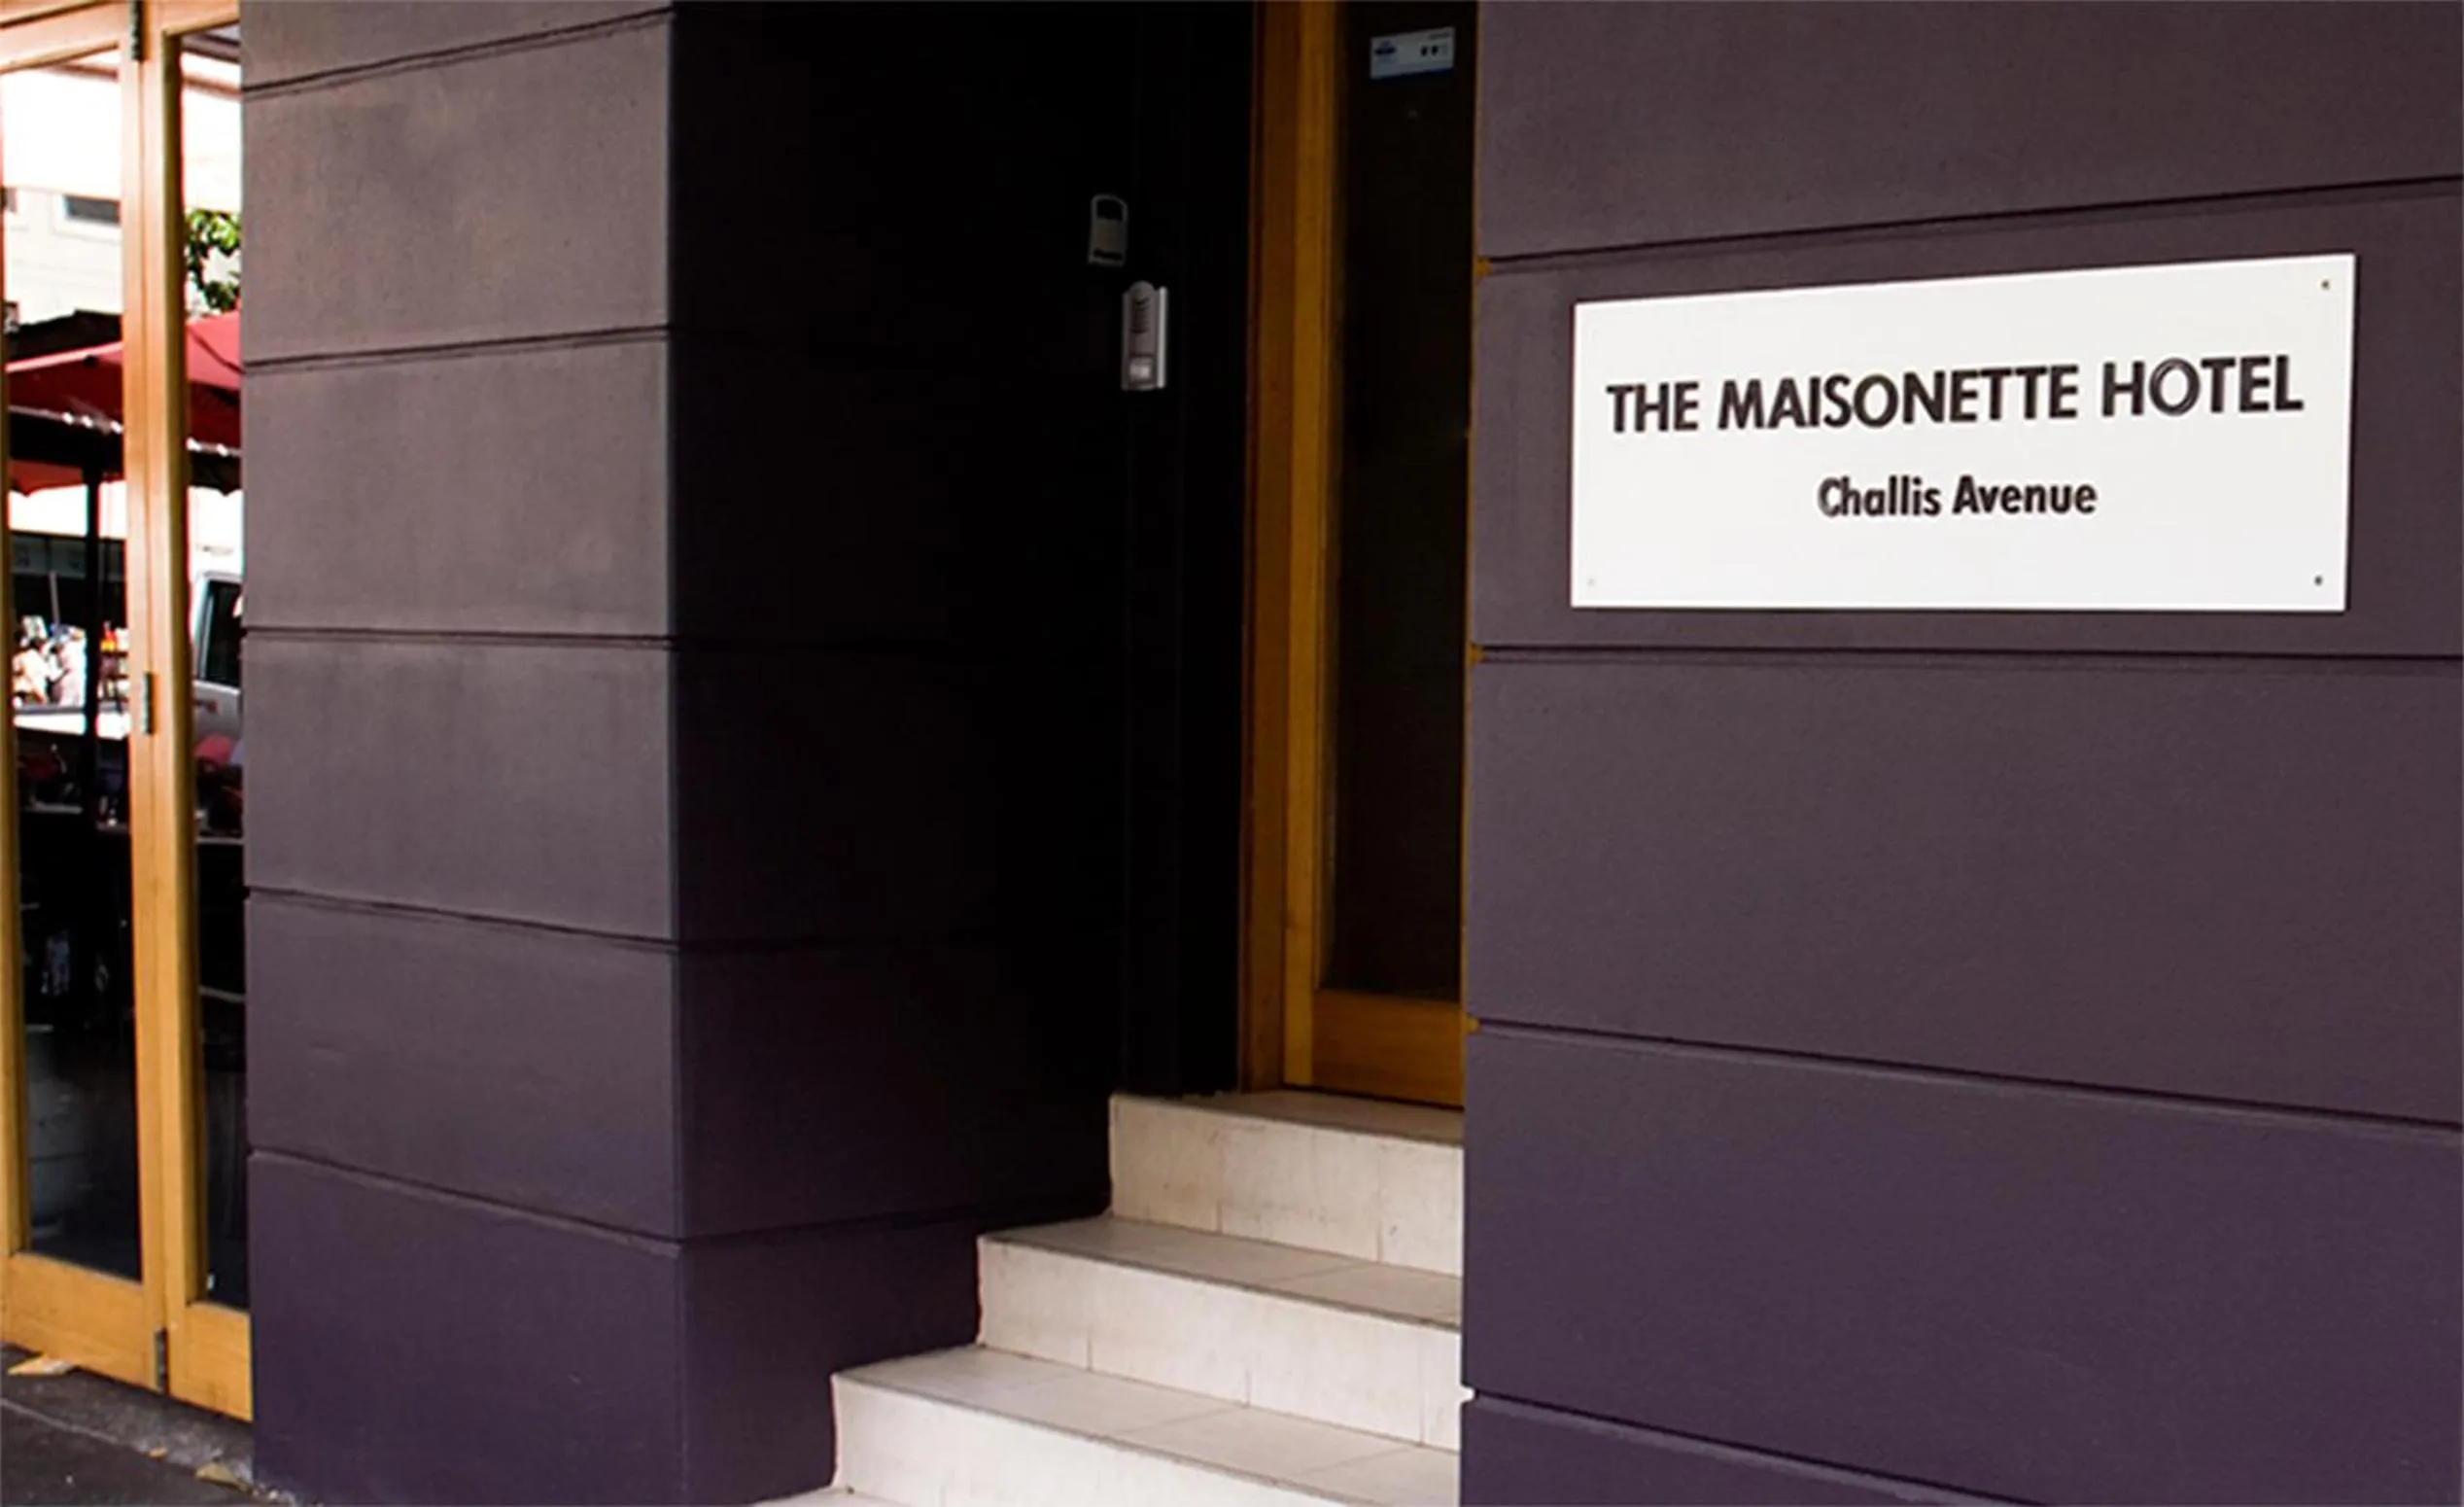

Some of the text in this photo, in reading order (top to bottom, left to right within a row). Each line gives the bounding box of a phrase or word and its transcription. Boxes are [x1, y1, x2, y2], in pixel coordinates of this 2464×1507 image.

[1606, 355, 2305, 434] THE MAISONETTE HOTEL
[1818, 474, 2098, 517] Challis Avenue
